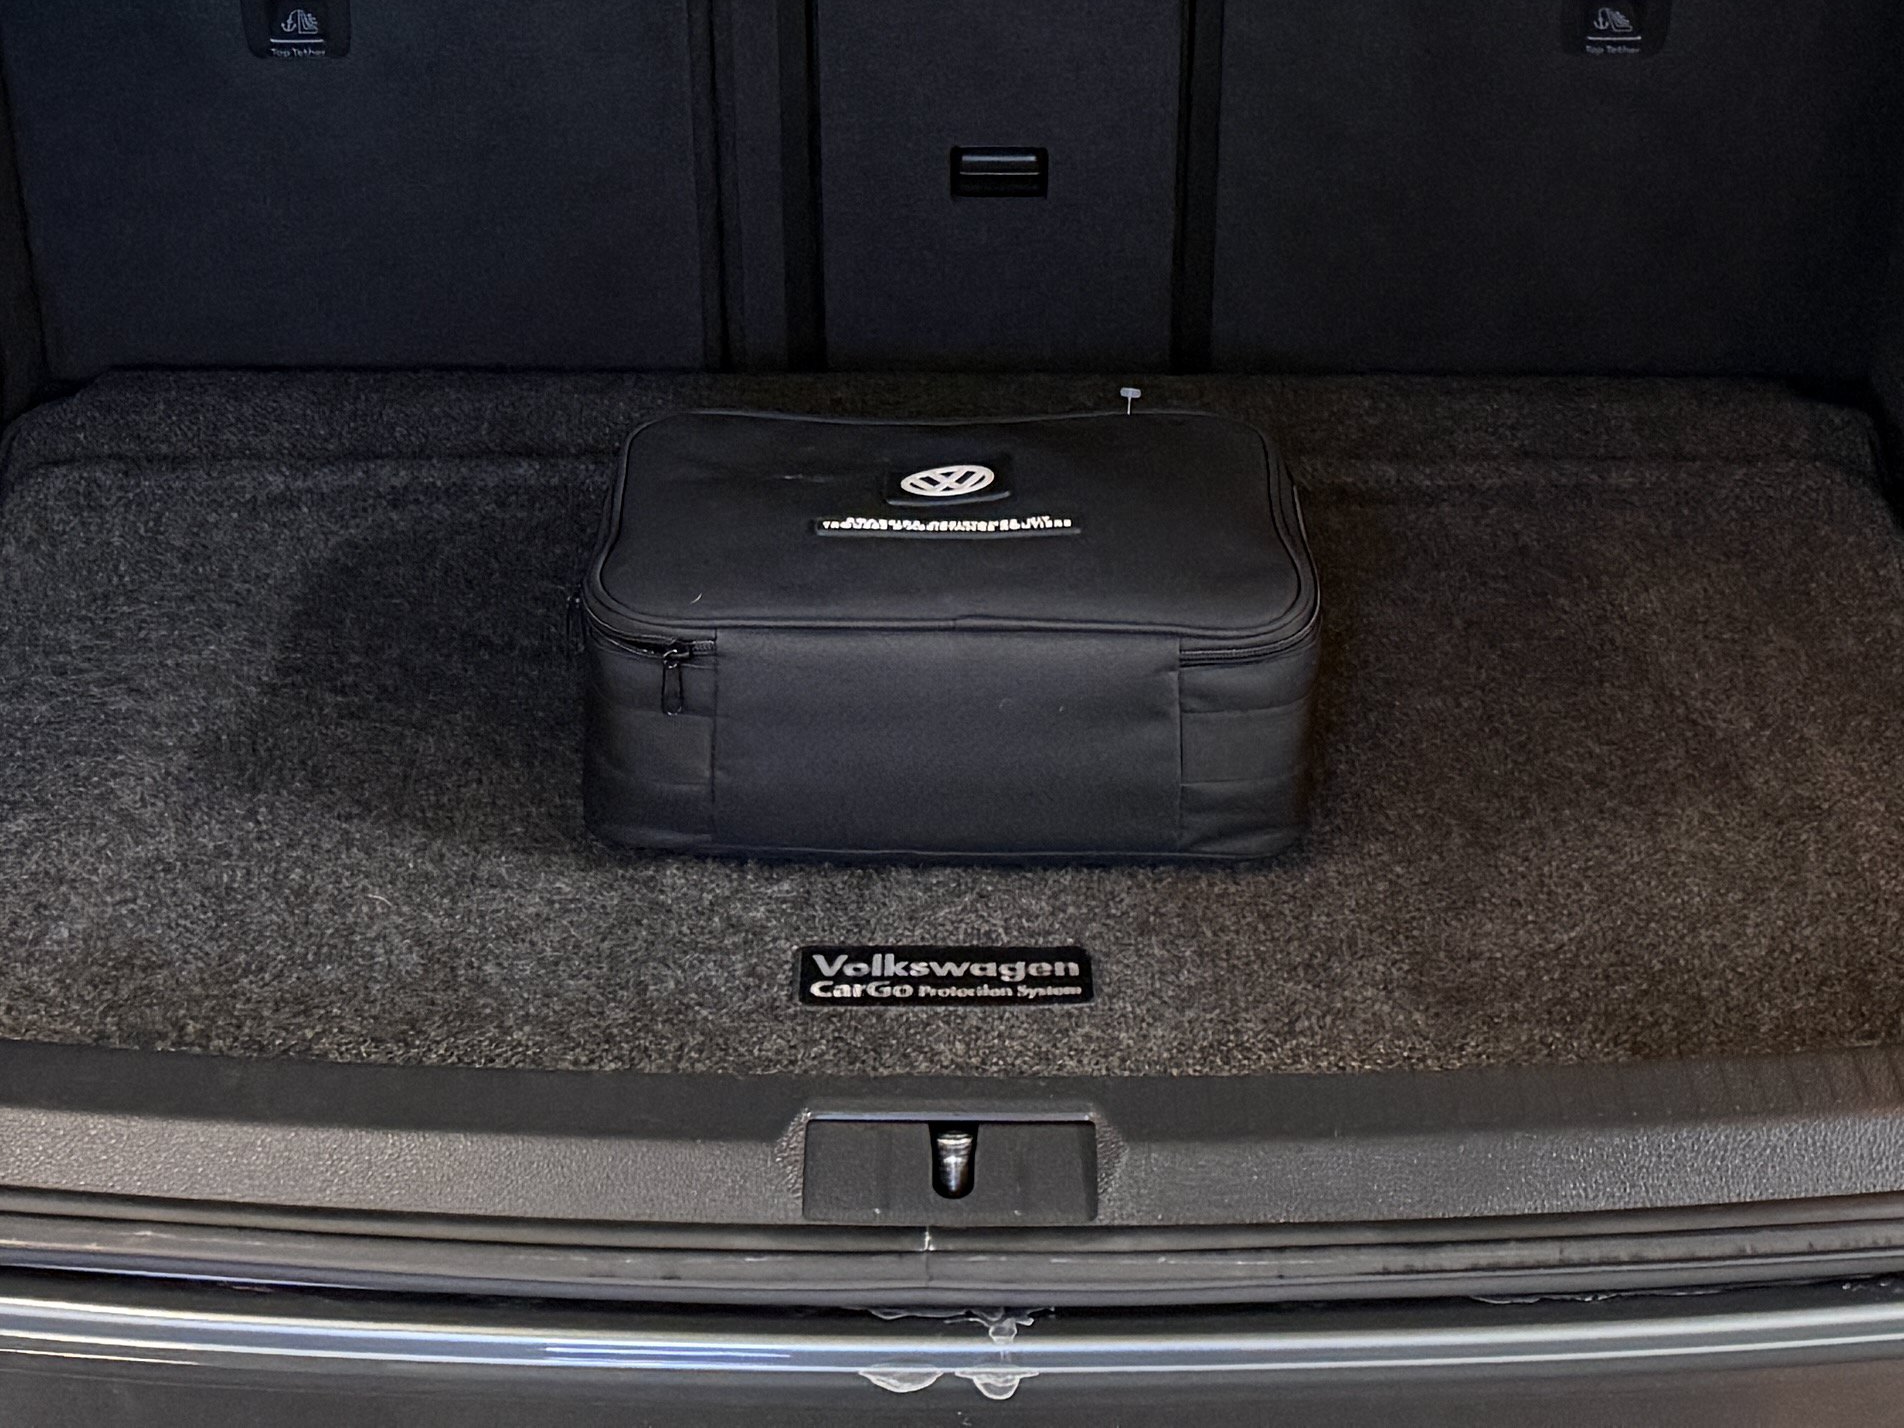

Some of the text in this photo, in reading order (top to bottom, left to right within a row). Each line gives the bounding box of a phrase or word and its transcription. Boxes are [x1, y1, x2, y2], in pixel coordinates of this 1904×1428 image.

[812, 953, 1080, 982] Volkswagen
[809, 980, 1083, 999] CarGo Protection System
